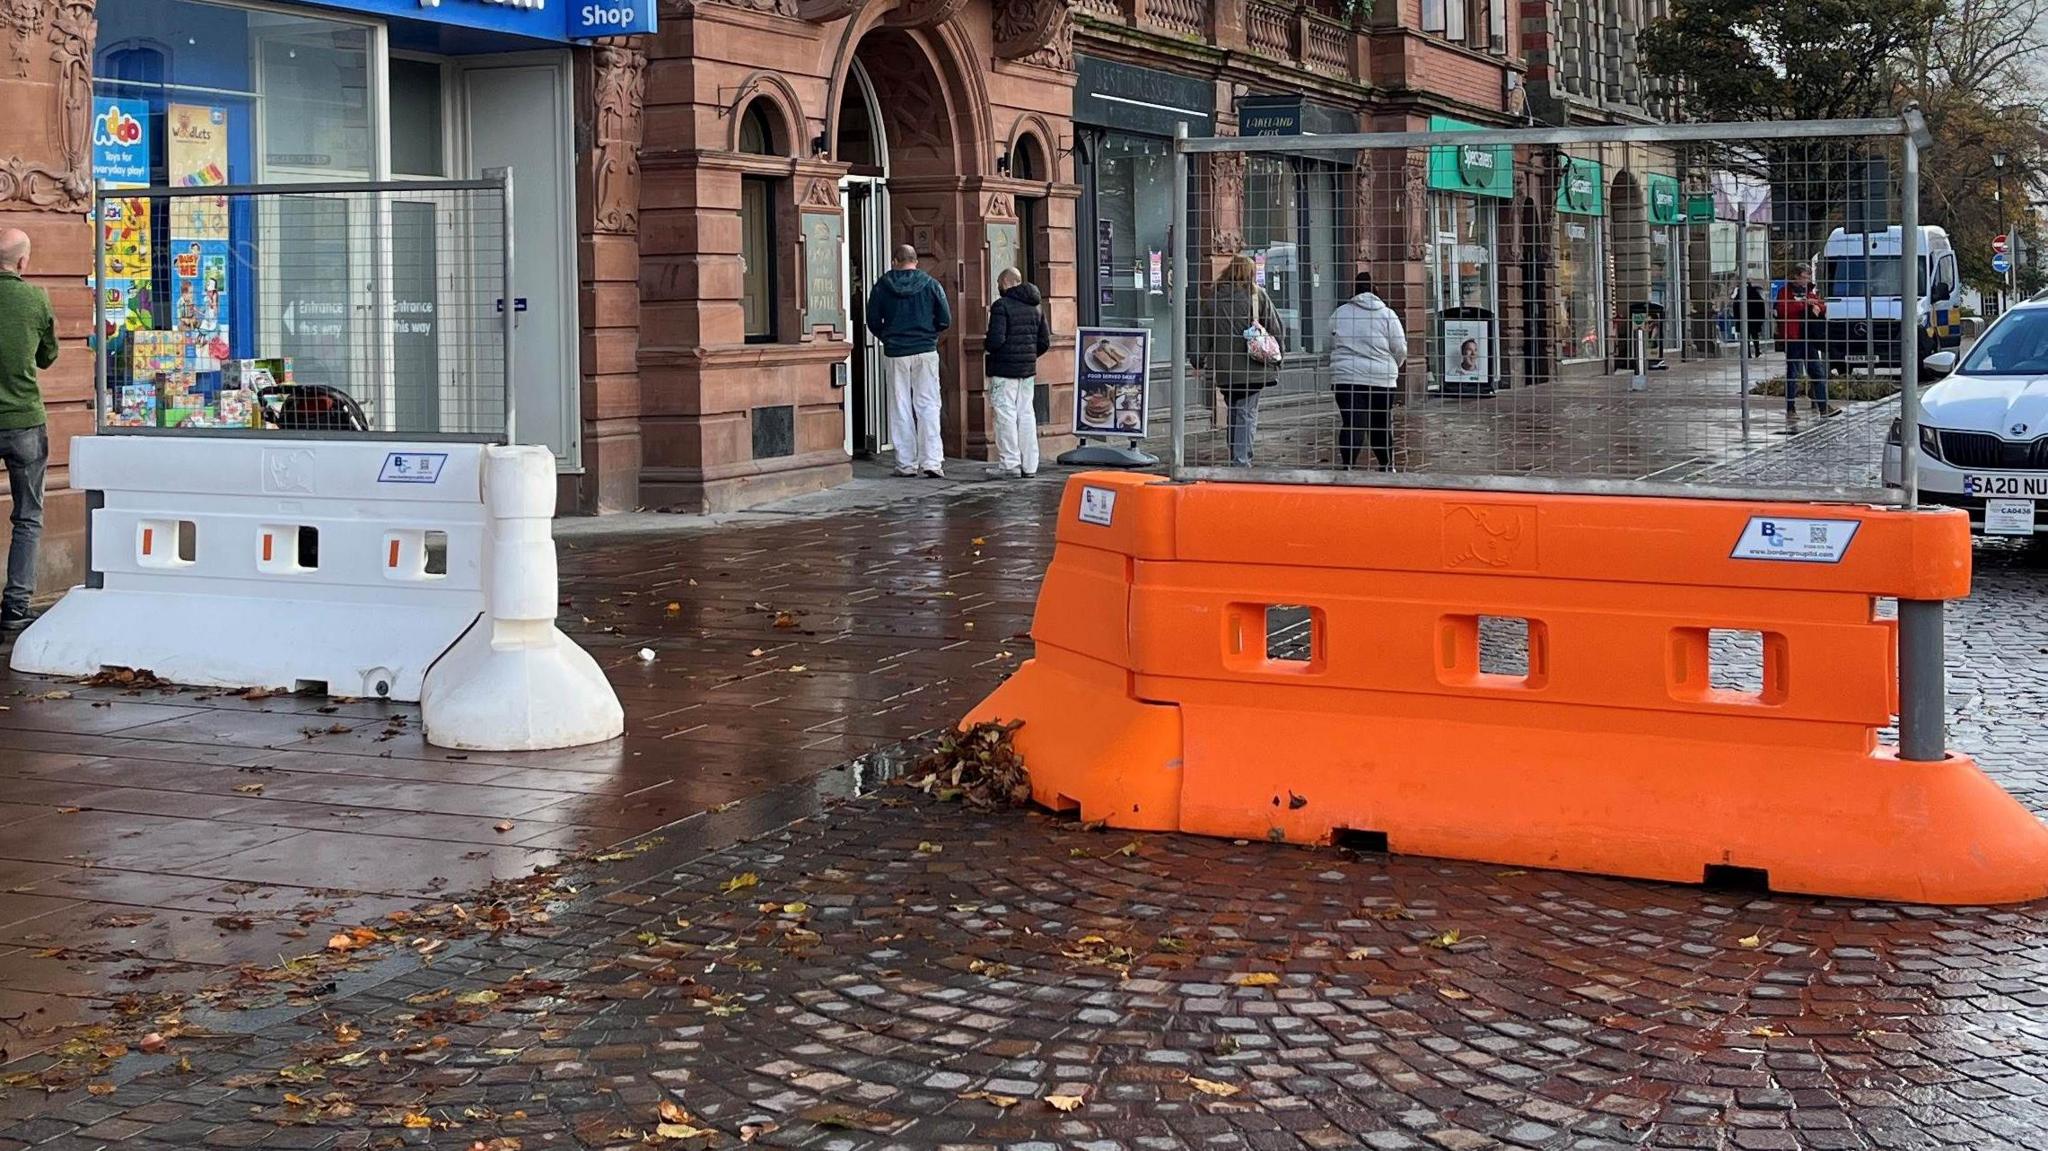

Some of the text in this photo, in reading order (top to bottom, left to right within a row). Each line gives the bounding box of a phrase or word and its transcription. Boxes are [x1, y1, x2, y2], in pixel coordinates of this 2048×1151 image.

[581, 5, 635, 28] Shop
[95, 106, 142, 146] Addo
[1246, 116, 1294, 129] LAKELAND
[104, 151, 132, 163] Toys for
[179, 254, 198, 264] BUSY
[180, 265, 196, 276] ME
[299, 300, 344, 314] Entrance
[393, 299, 433, 313] Entrance
[299, 320, 342, 338] this way
[411, 321, 431, 336] way
[1972, 477, 2018, 494] SA20
[2001, 507, 2031, 515] CA0436
